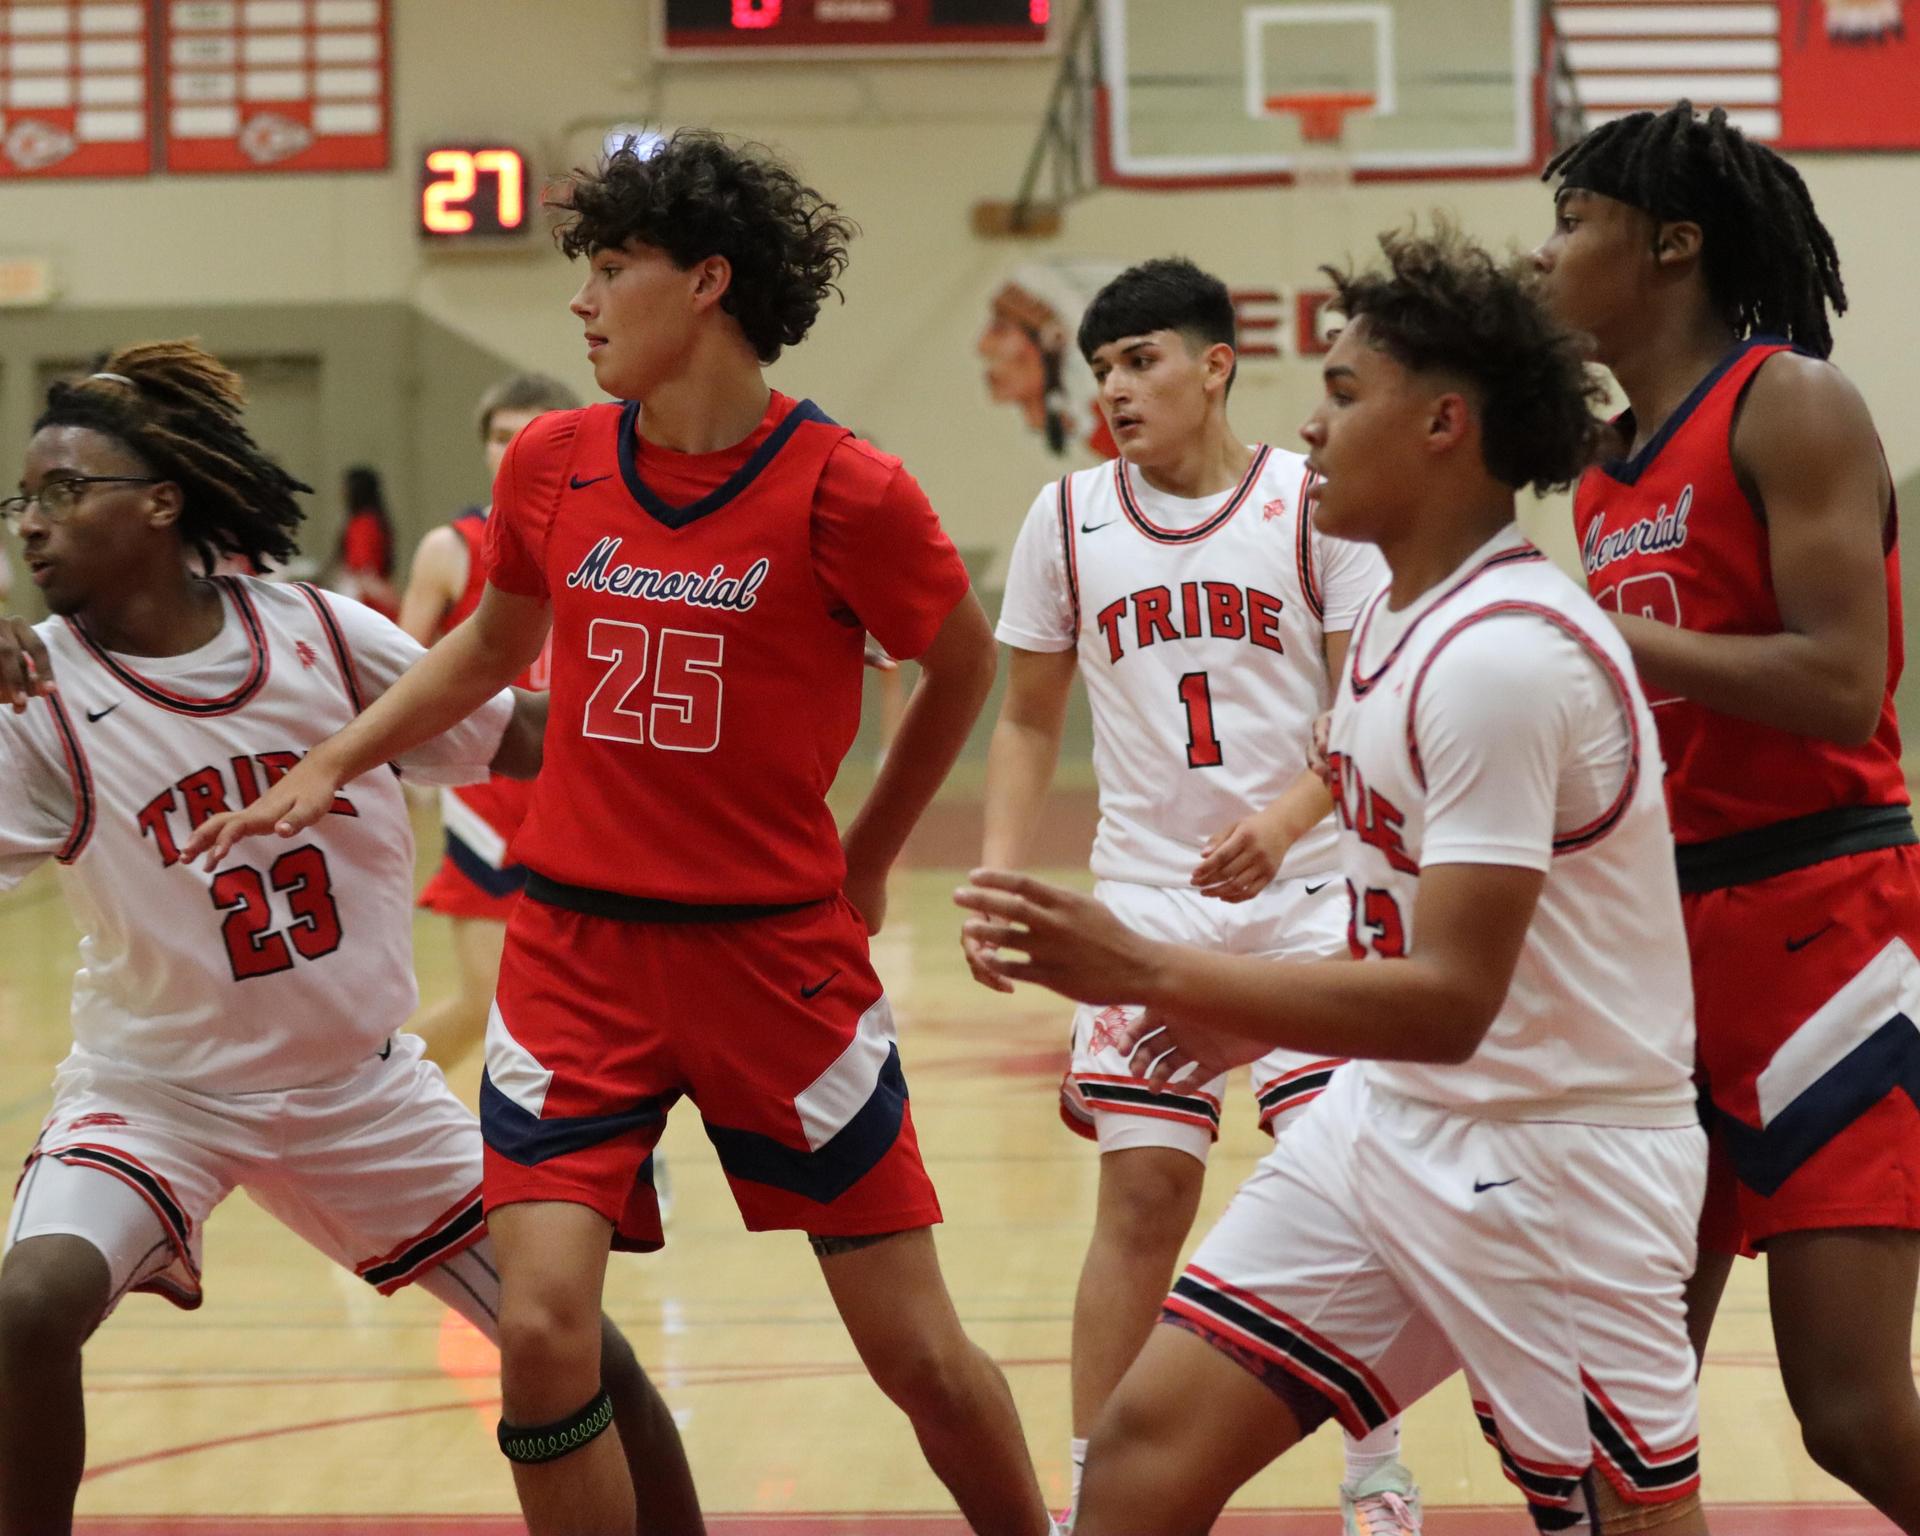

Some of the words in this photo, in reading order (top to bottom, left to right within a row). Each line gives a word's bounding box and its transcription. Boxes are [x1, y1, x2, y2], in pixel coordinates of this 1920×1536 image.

[422, 148, 523, 235] 27
[567, 536, 769, 612] Memorial
[1583, 484, 1693, 575] Memorial
[1097, 581, 1285, 665] TRIBE
[582, 618, 724, 753] 25
[1178, 671, 1223, 769] 1
[136, 750, 361, 869] TRI
[208, 843, 344, 982] 23
